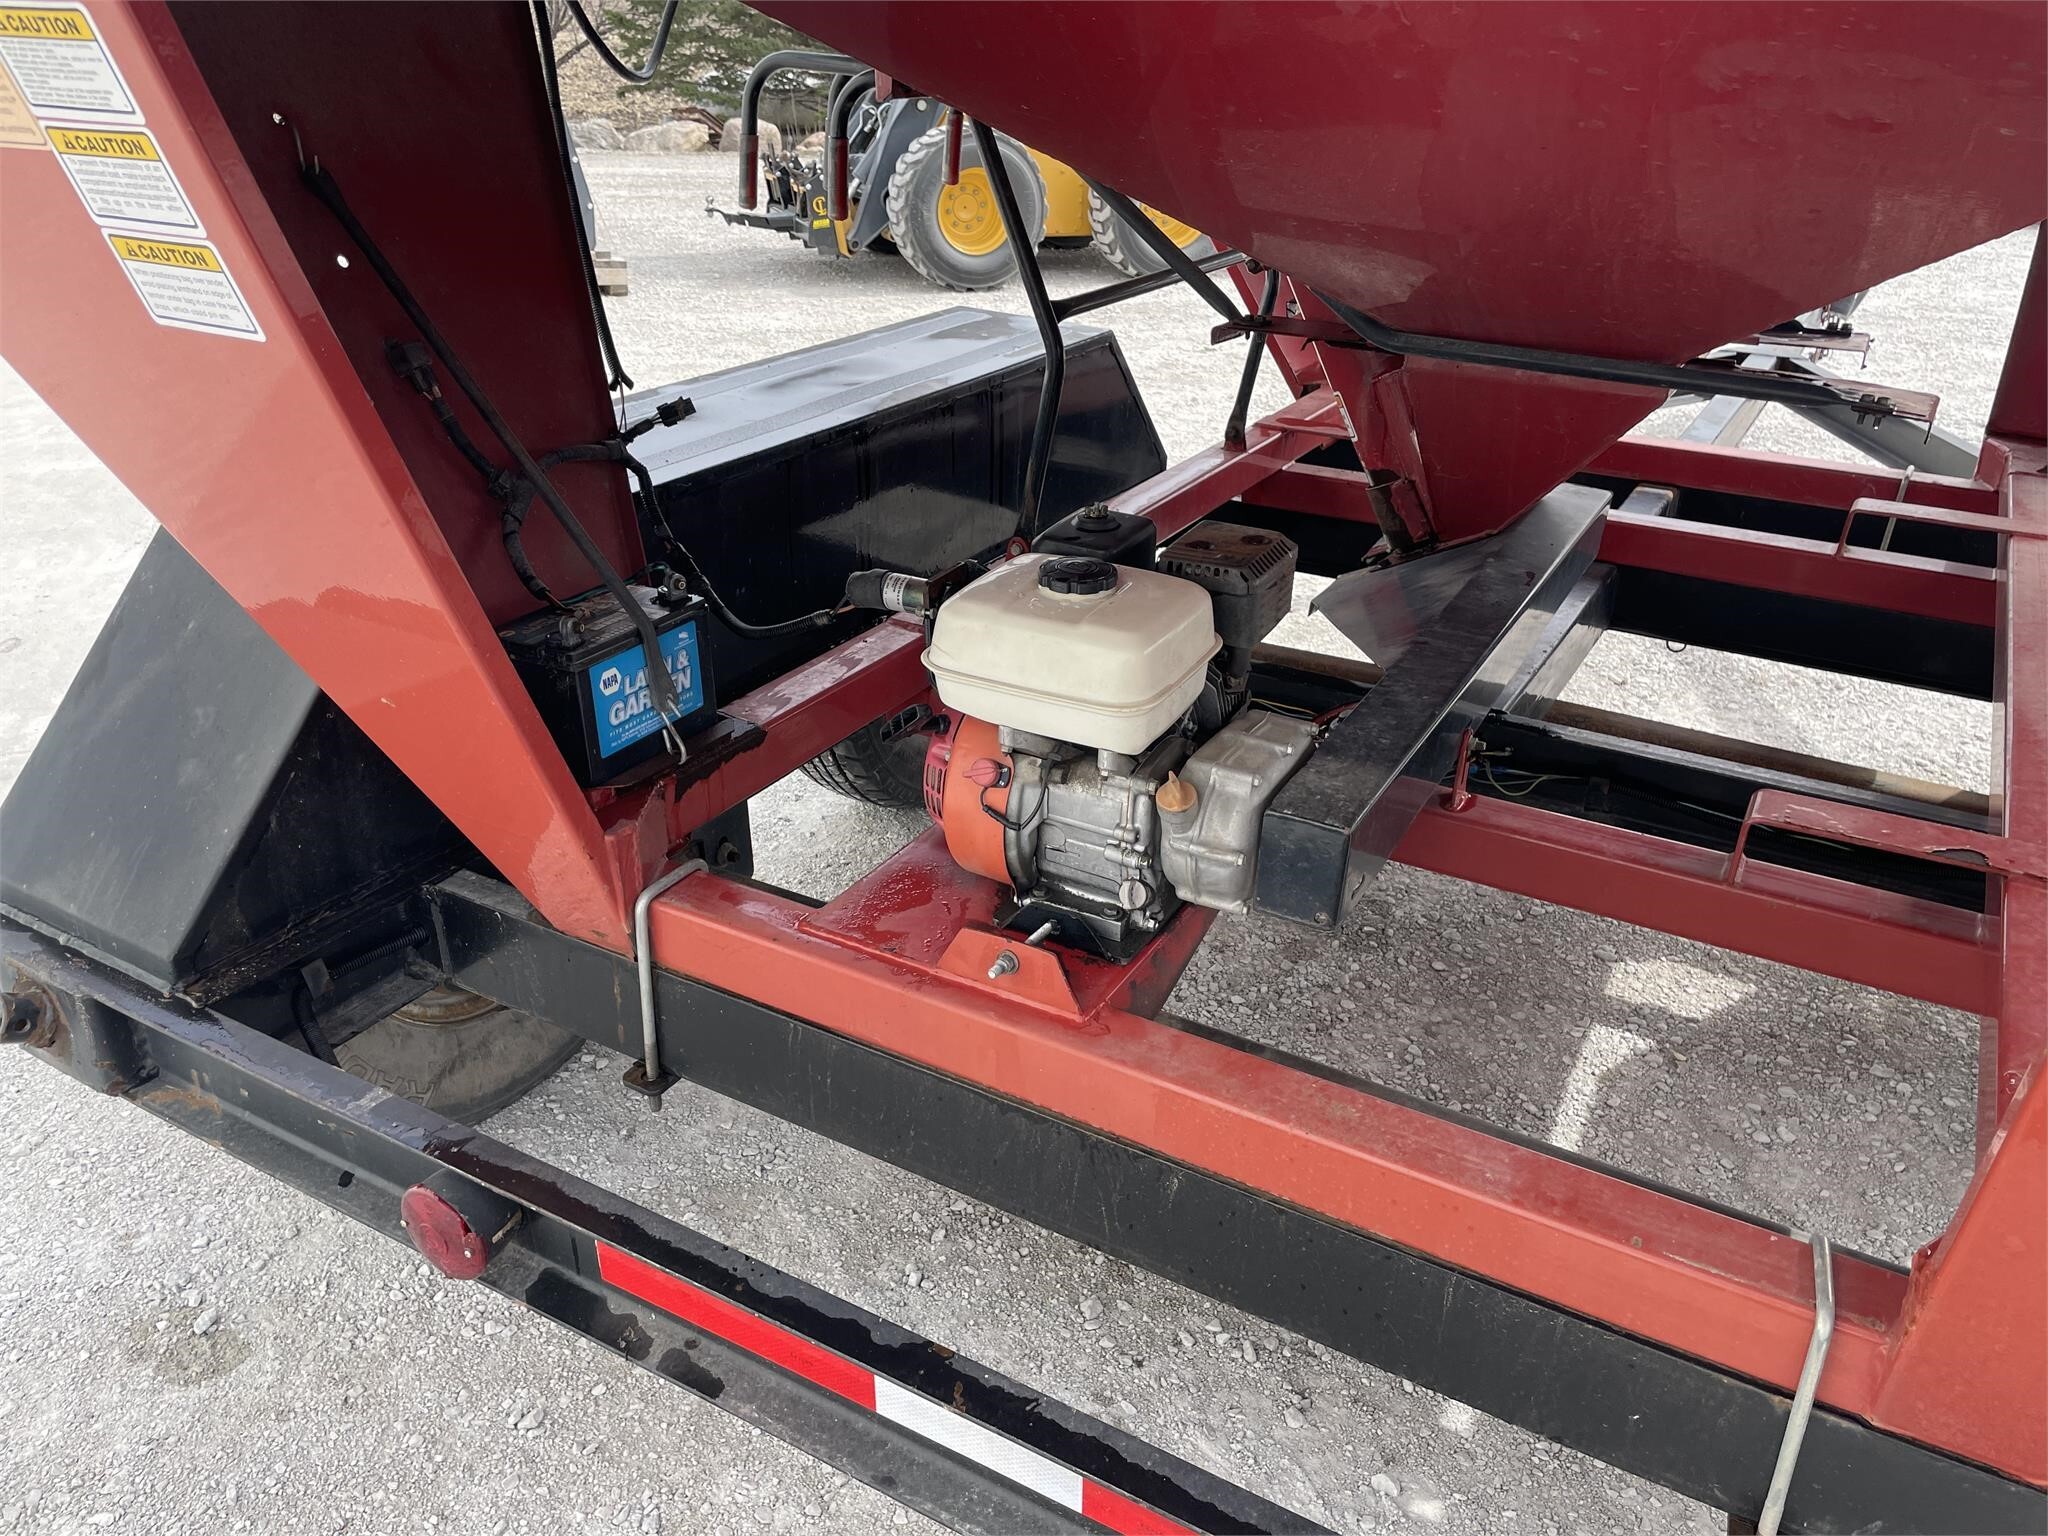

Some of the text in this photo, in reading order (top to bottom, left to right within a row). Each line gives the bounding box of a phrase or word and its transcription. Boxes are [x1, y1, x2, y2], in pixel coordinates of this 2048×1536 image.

[5, 14, 81, 35] CAUTION
[74, 135, 147, 156] CAUTION
[138, 244, 209, 267] CAUTION
[602, 672, 619, 690] NAPA
[623, 648, 690, 696] LAN &
[608, 667, 692, 727] GARN
